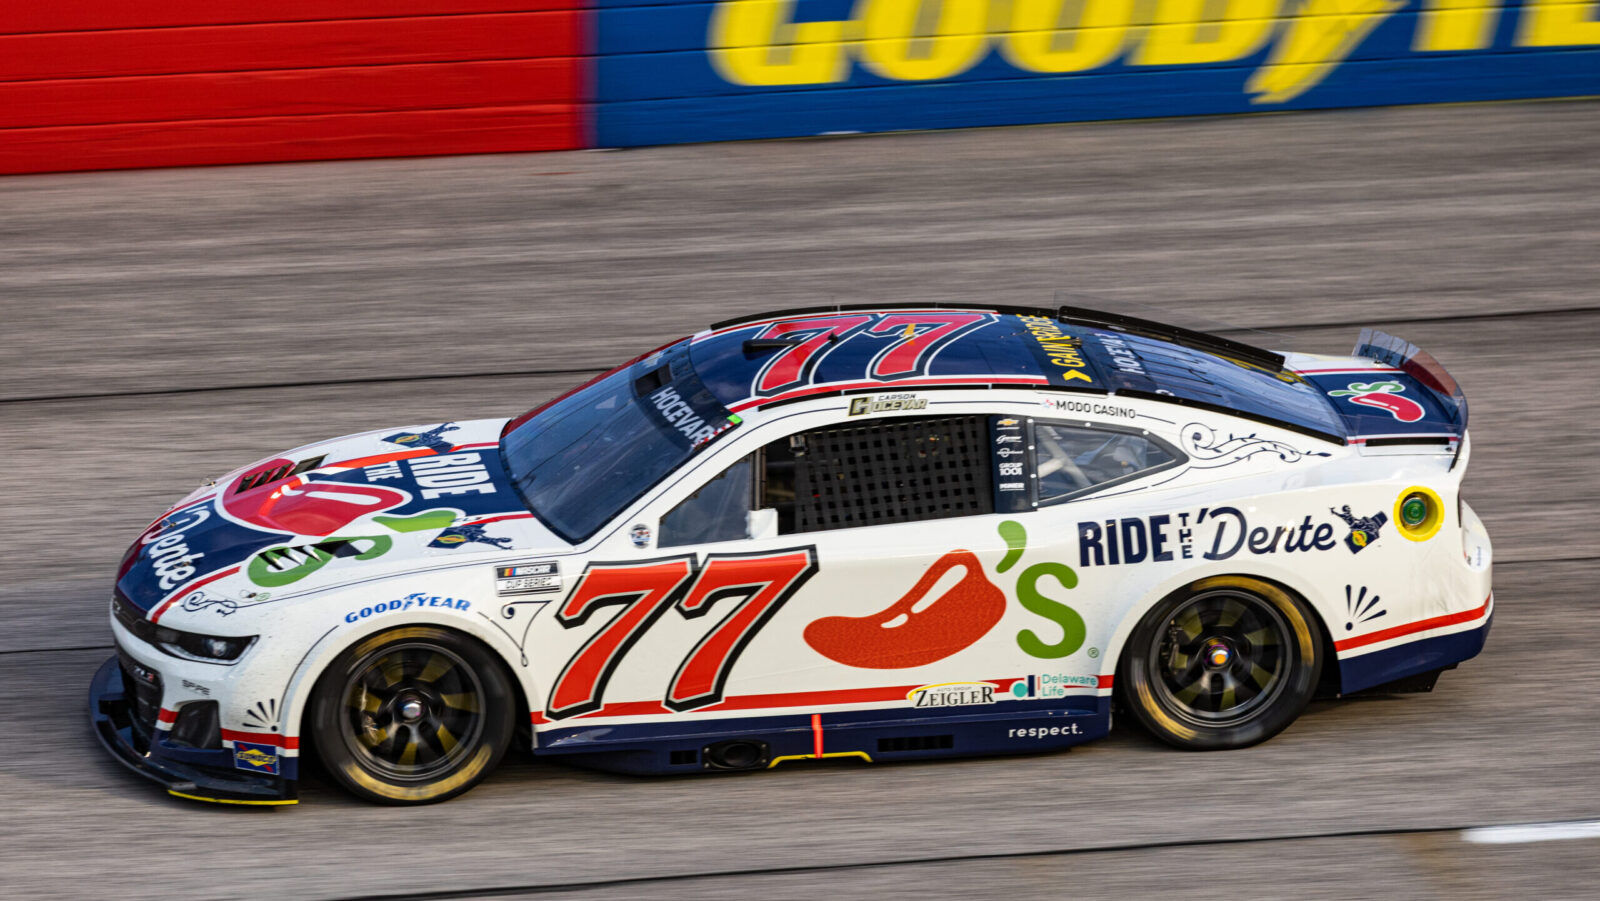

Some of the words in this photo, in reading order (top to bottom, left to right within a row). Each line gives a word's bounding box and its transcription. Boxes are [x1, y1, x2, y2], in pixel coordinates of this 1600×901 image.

[750, 311, 1000, 397] 77
[1056, 400, 1091, 413] MODO
[1093, 403, 1136, 419] CASINO
[363, 461, 403, 482] THE
[407, 452, 497, 499] RIDE
[1077, 513, 1174, 567] RIDE
[1178, 512, 1193, 559] THE
[506, 579, 522, 589] CUP
[523, 577, 552, 588] SERIES
[344, 592, 471, 623] GOODYEAR
[546, 545, 818, 721] 77
[1042, 674, 1098, 686] Delaware
[915, 686, 995, 707] ZEIGLER
[1042, 687, 1065, 697] Life
[1008, 722, 1084, 739] respect.
